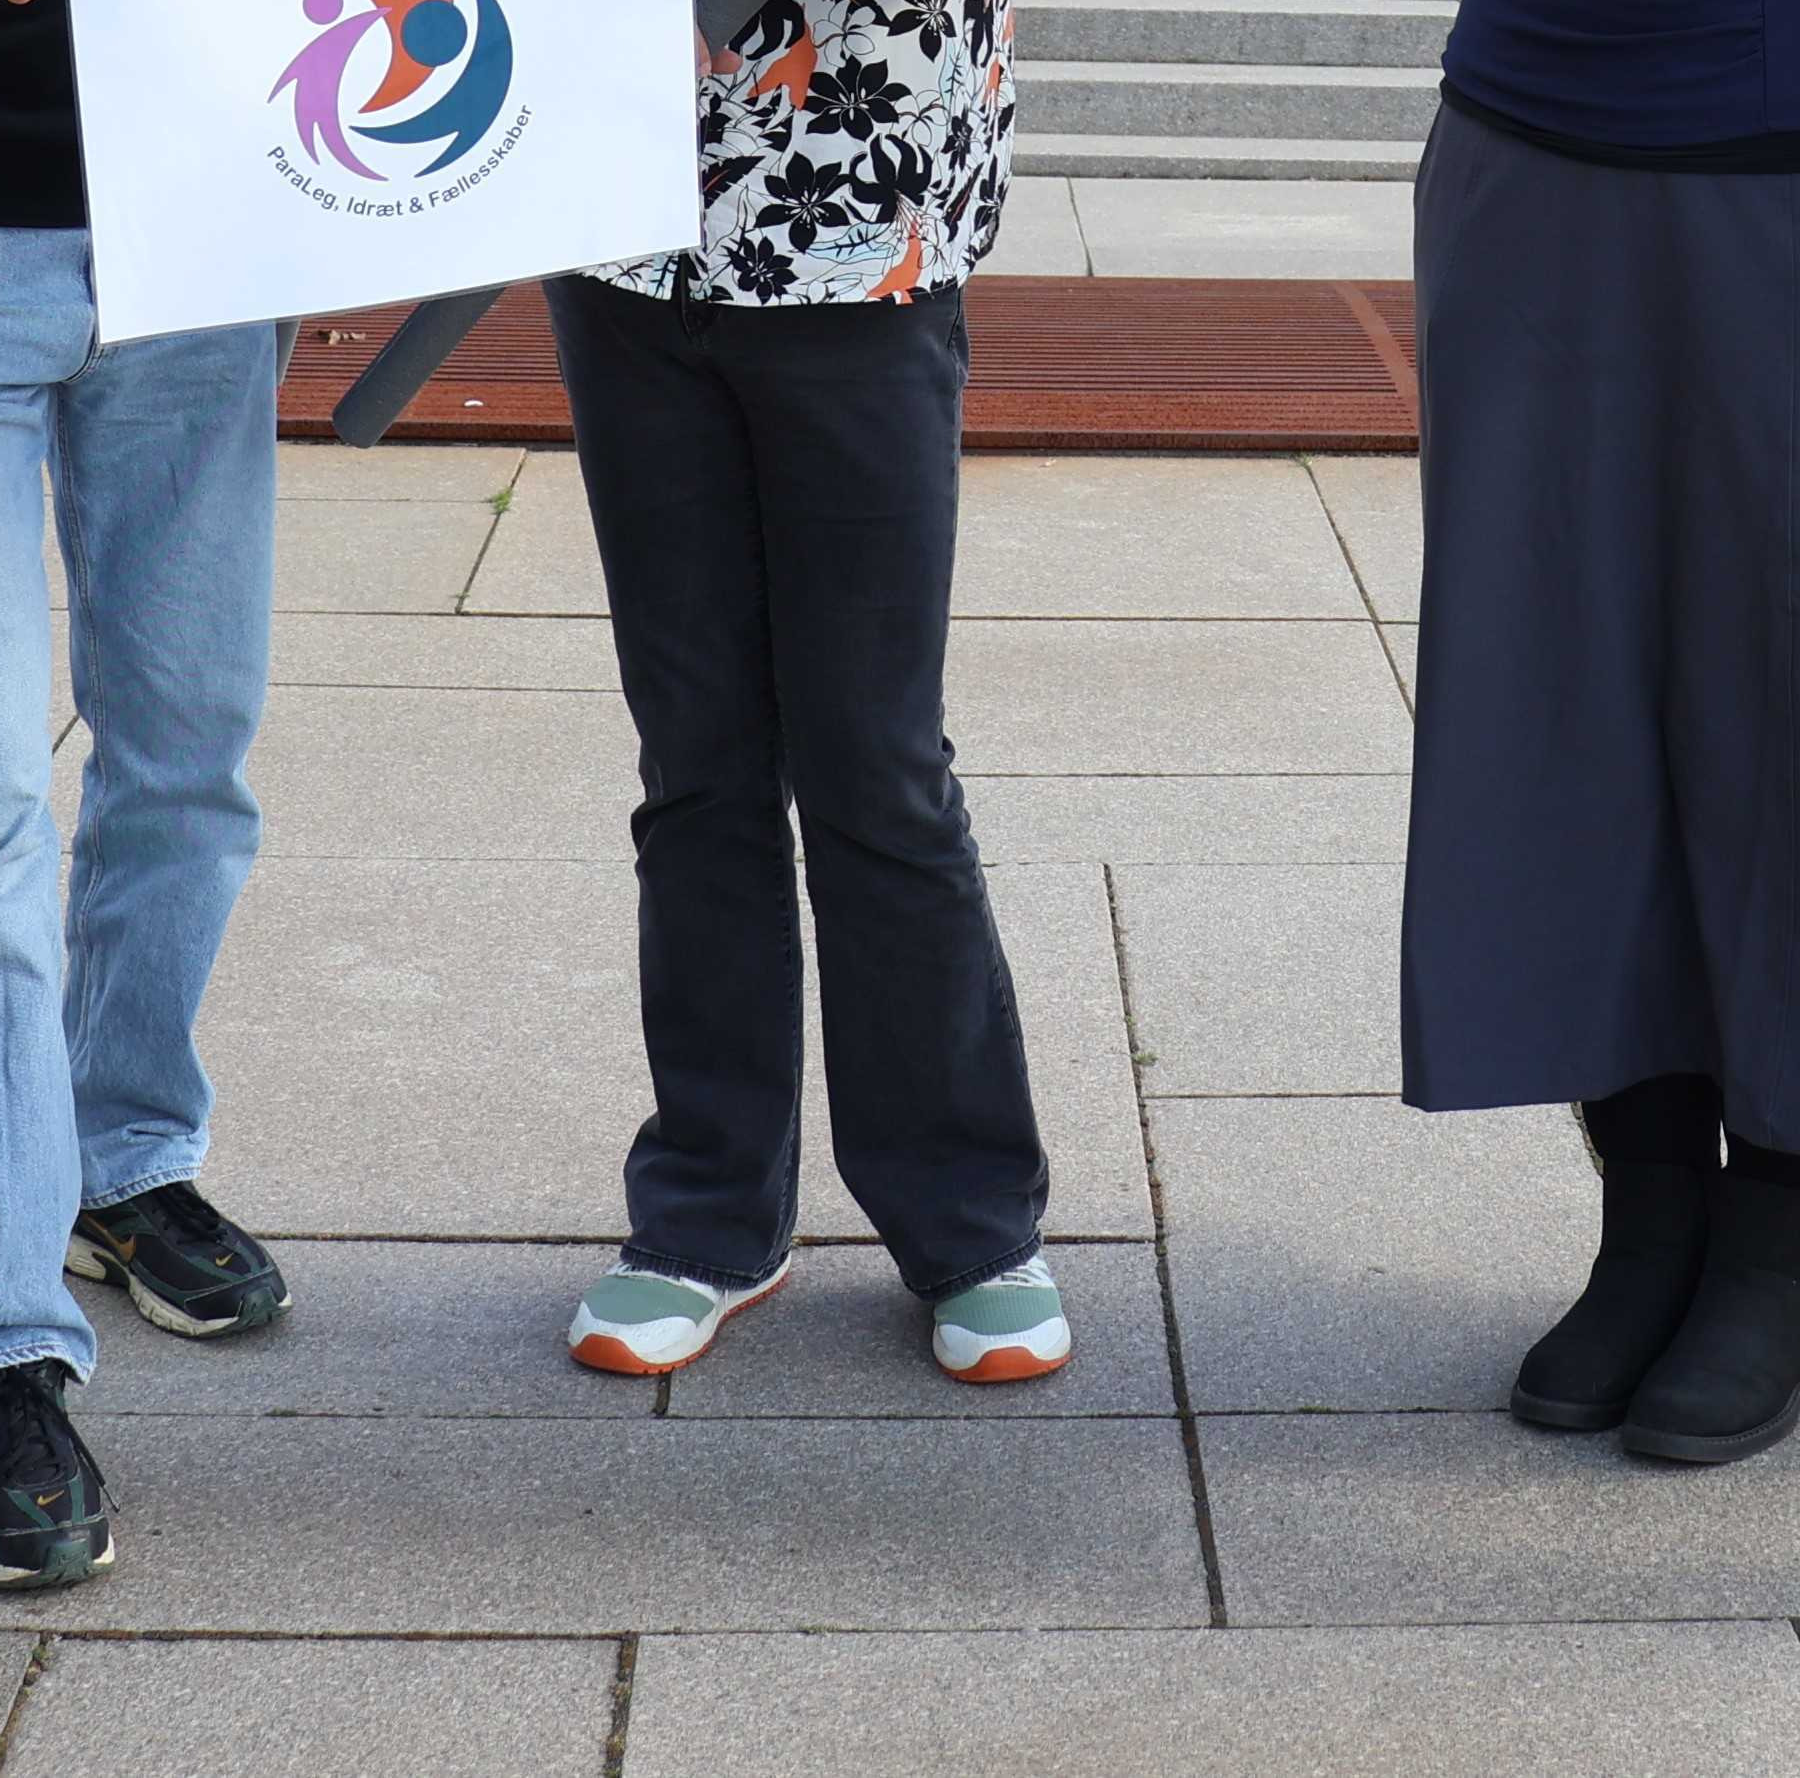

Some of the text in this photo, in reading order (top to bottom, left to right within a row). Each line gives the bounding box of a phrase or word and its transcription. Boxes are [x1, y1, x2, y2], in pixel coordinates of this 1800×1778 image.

[266, 104, 533, 218] ParaLeg, Idræt & Fællesskaber
